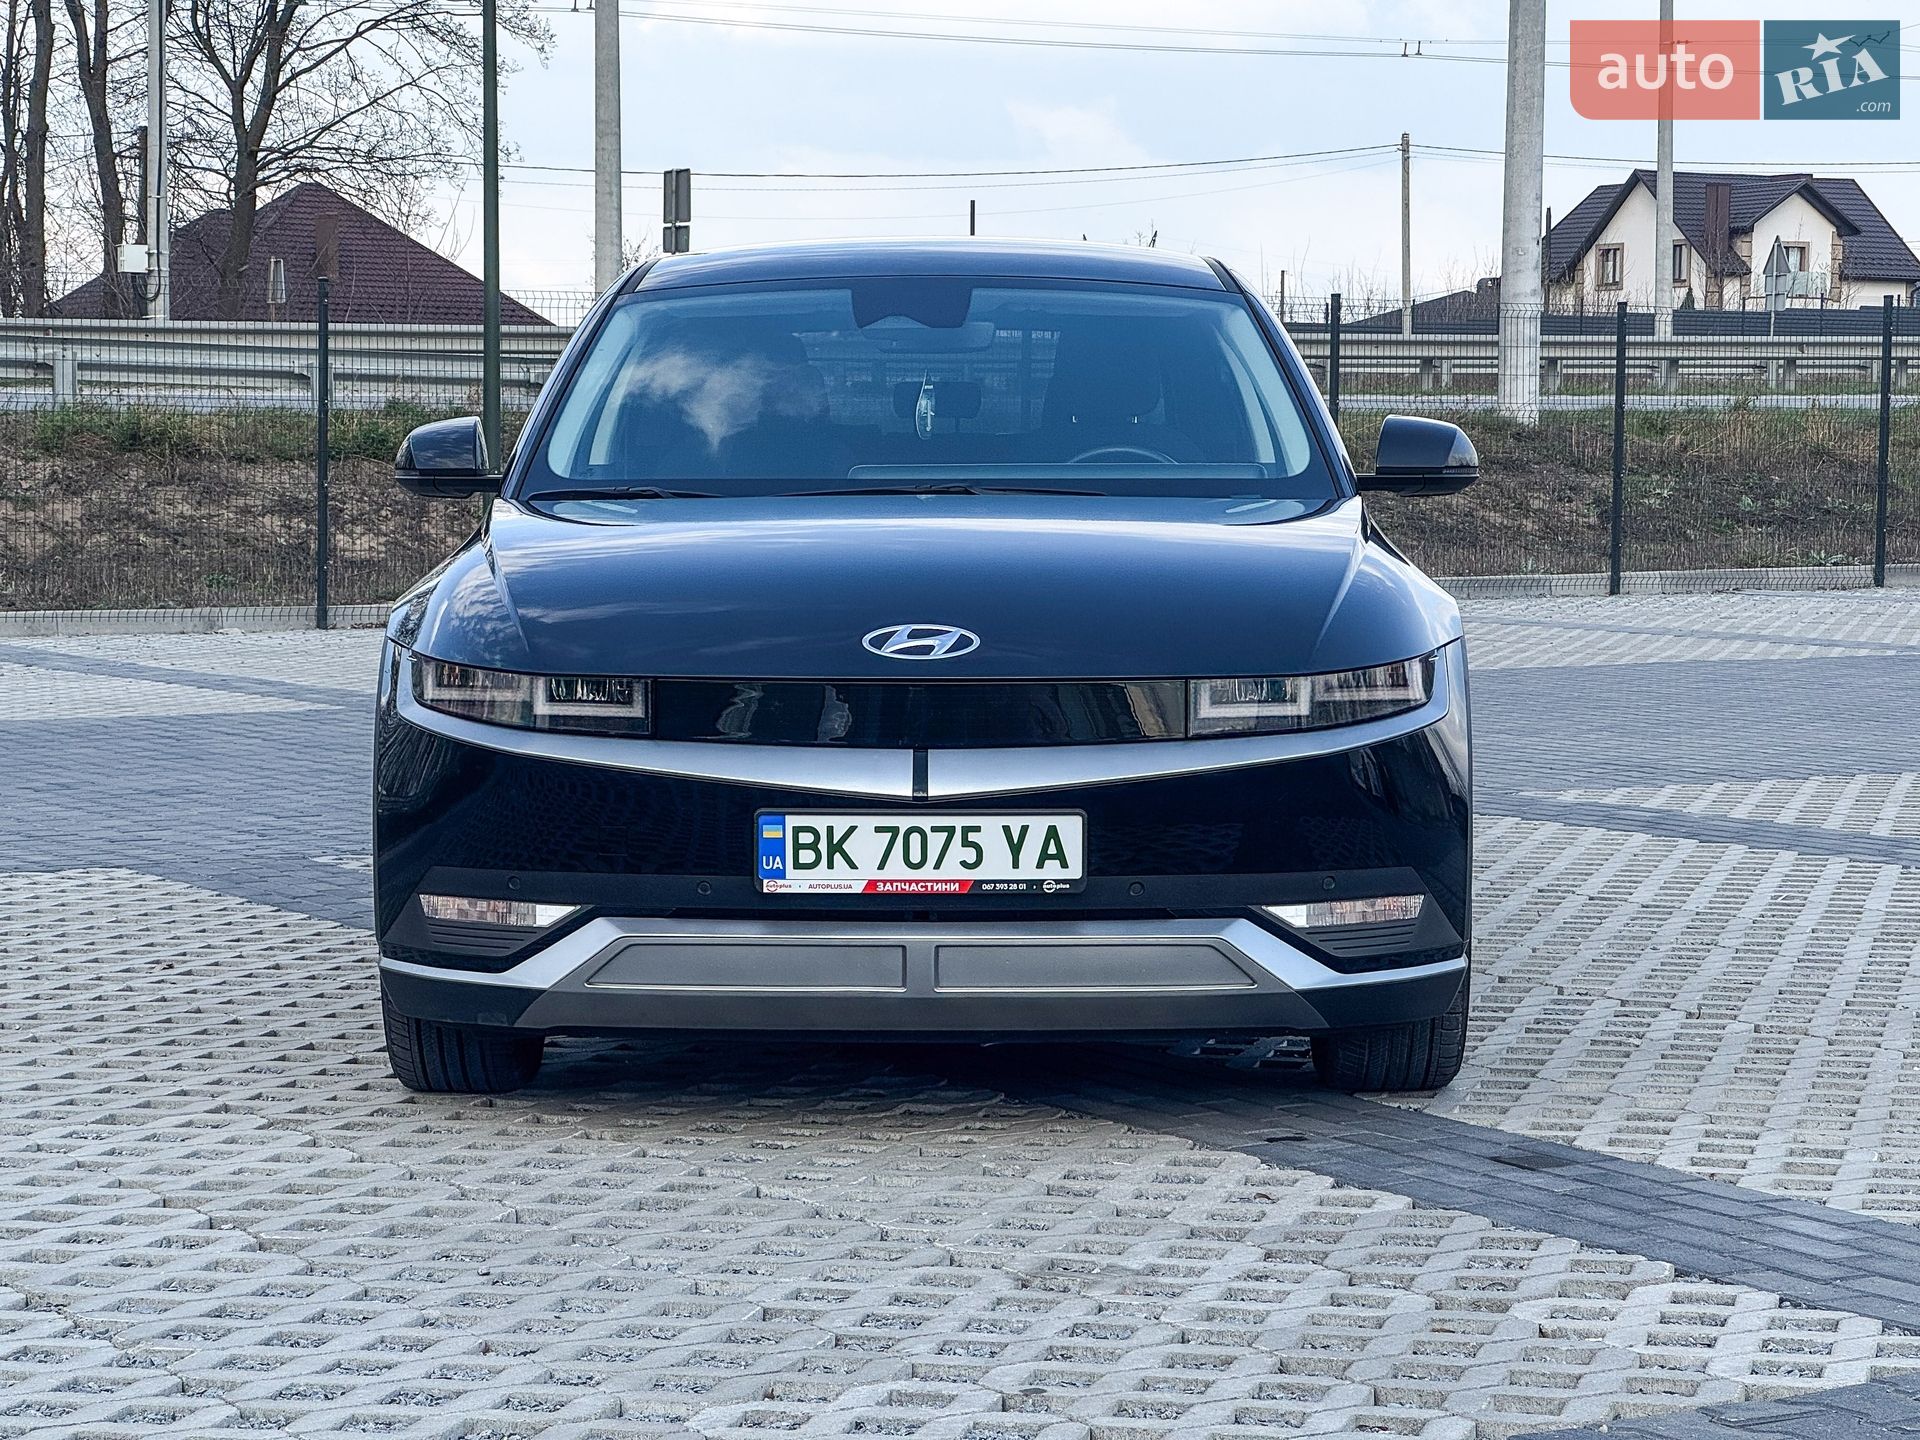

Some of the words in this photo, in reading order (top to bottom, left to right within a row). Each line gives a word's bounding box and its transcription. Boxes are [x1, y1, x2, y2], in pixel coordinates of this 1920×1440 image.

[792, 825, 859, 870] BK
[874, 825, 984, 870] 7075
[1001, 824, 1070, 870] YA
[762, 855, 783, 870] UA
[876, 882, 960, 891] ЗАПЧАСТИНИ
